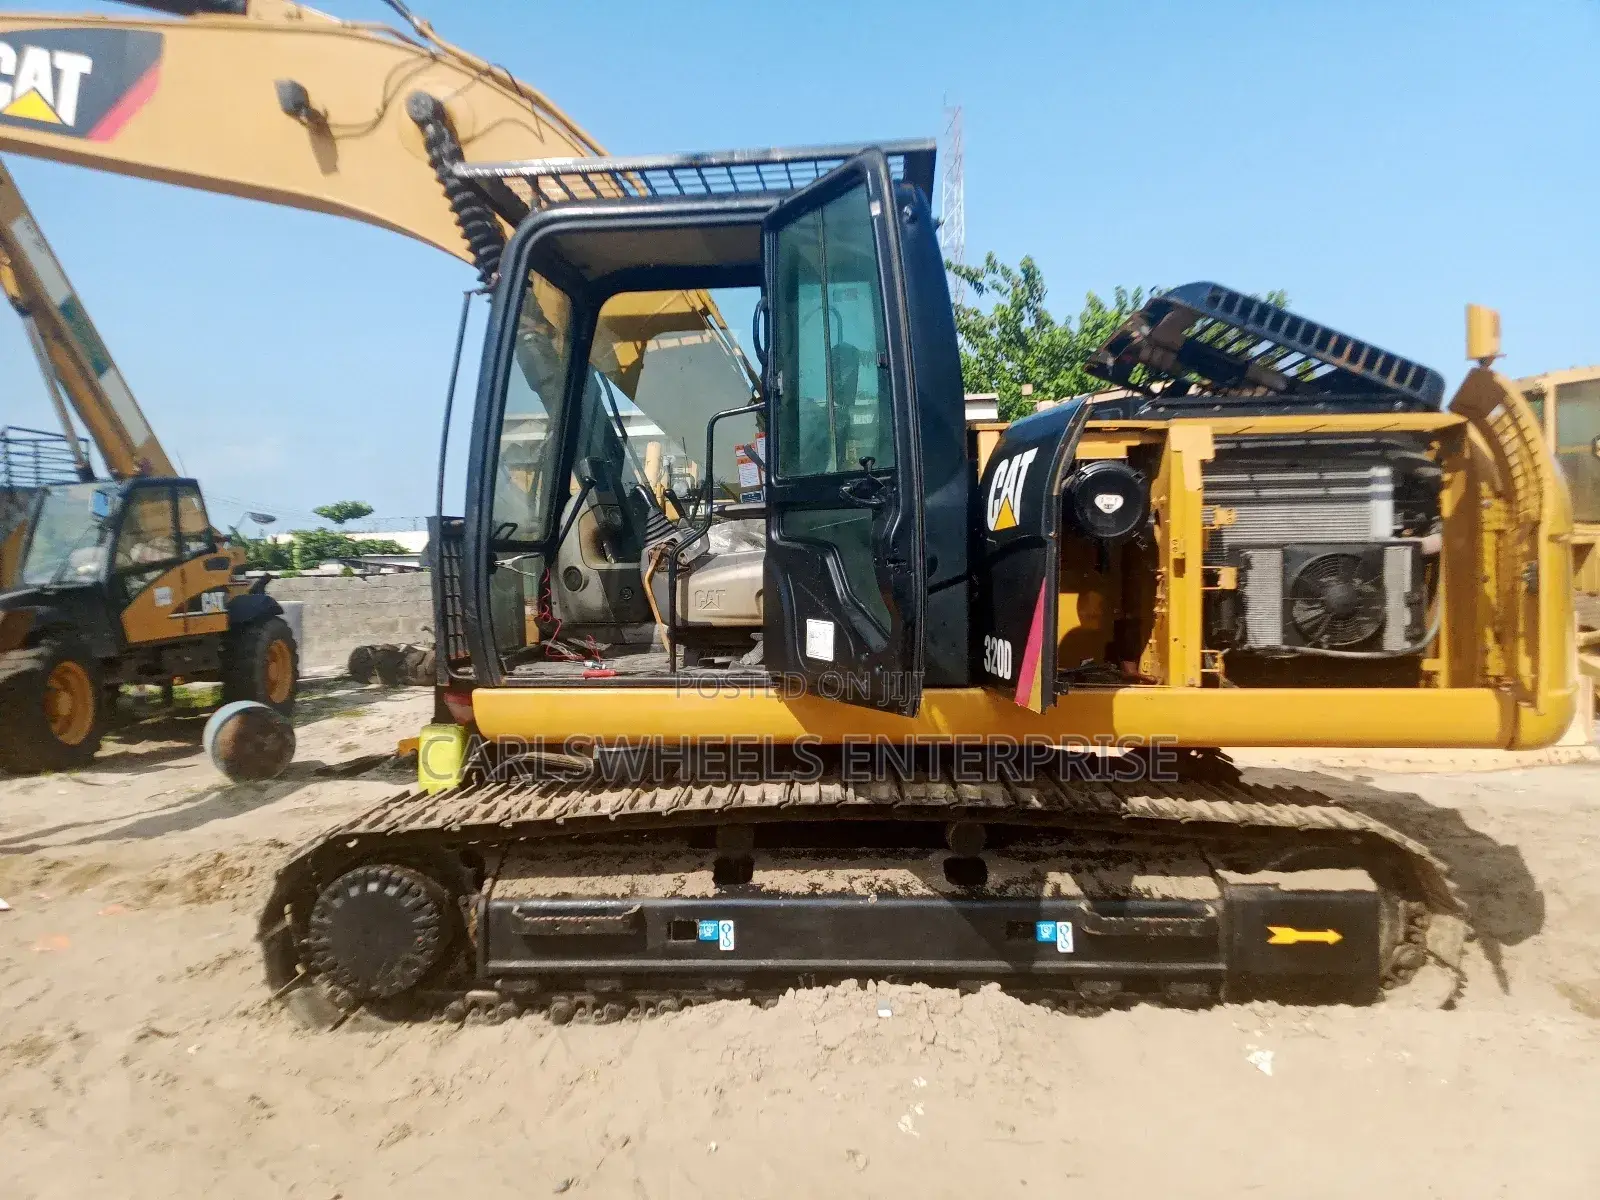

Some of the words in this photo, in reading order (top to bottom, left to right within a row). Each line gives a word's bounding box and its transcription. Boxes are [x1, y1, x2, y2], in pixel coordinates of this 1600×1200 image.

[987, 447, 1039, 531] CAT
[694, 590, 726, 610] CAT
[983, 634, 1012, 680] 320D
